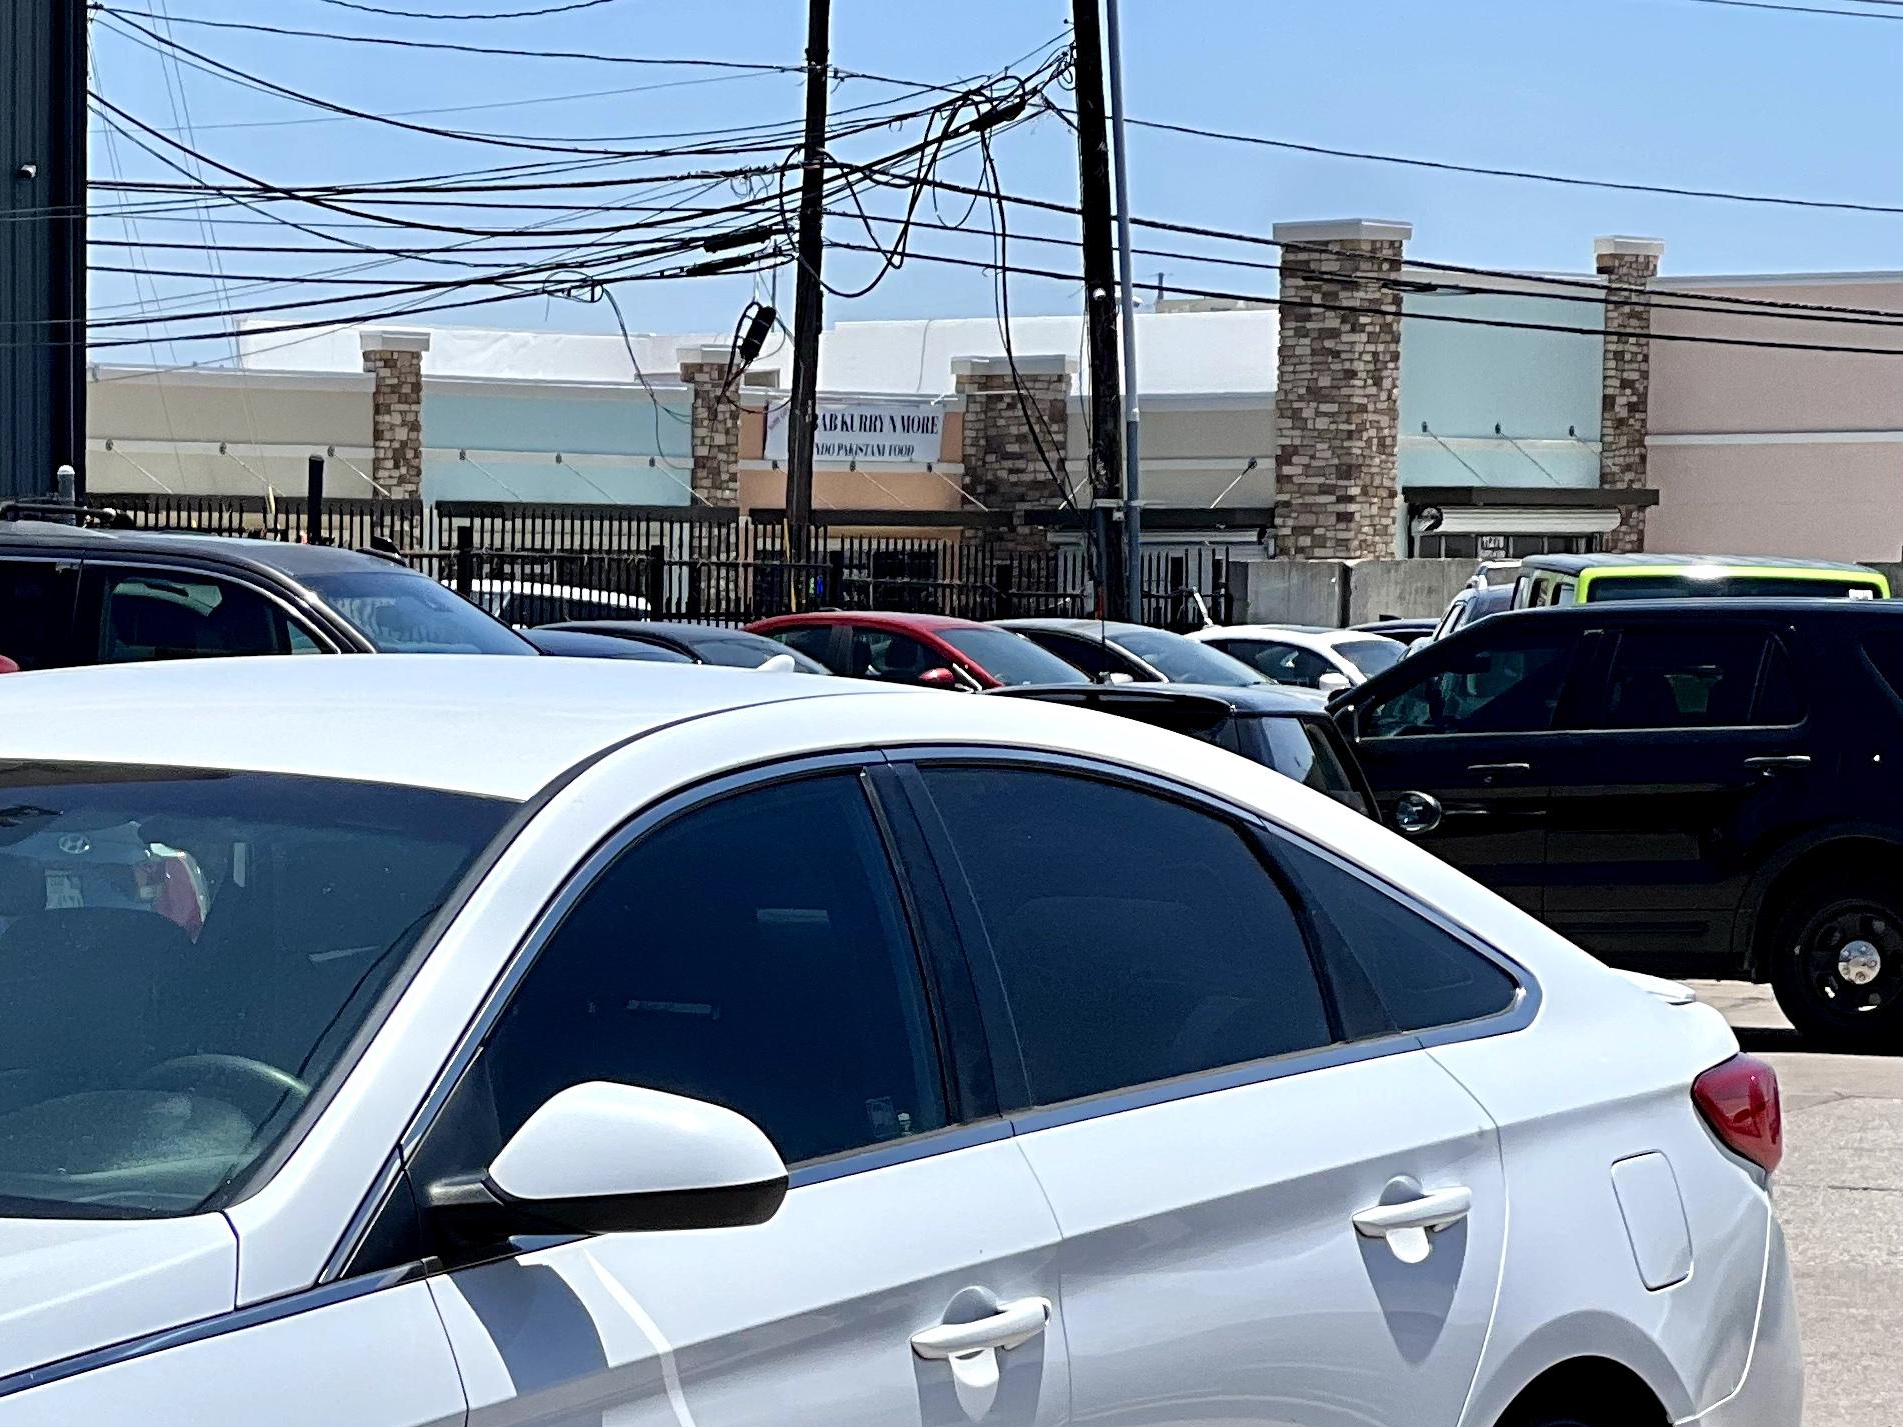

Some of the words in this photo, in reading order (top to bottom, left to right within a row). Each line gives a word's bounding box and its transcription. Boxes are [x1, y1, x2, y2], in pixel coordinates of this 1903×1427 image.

[840, 413, 884, 433] KURRY
[900, 415, 939, 435] MORE
[815, 442, 835, 456] NDO
